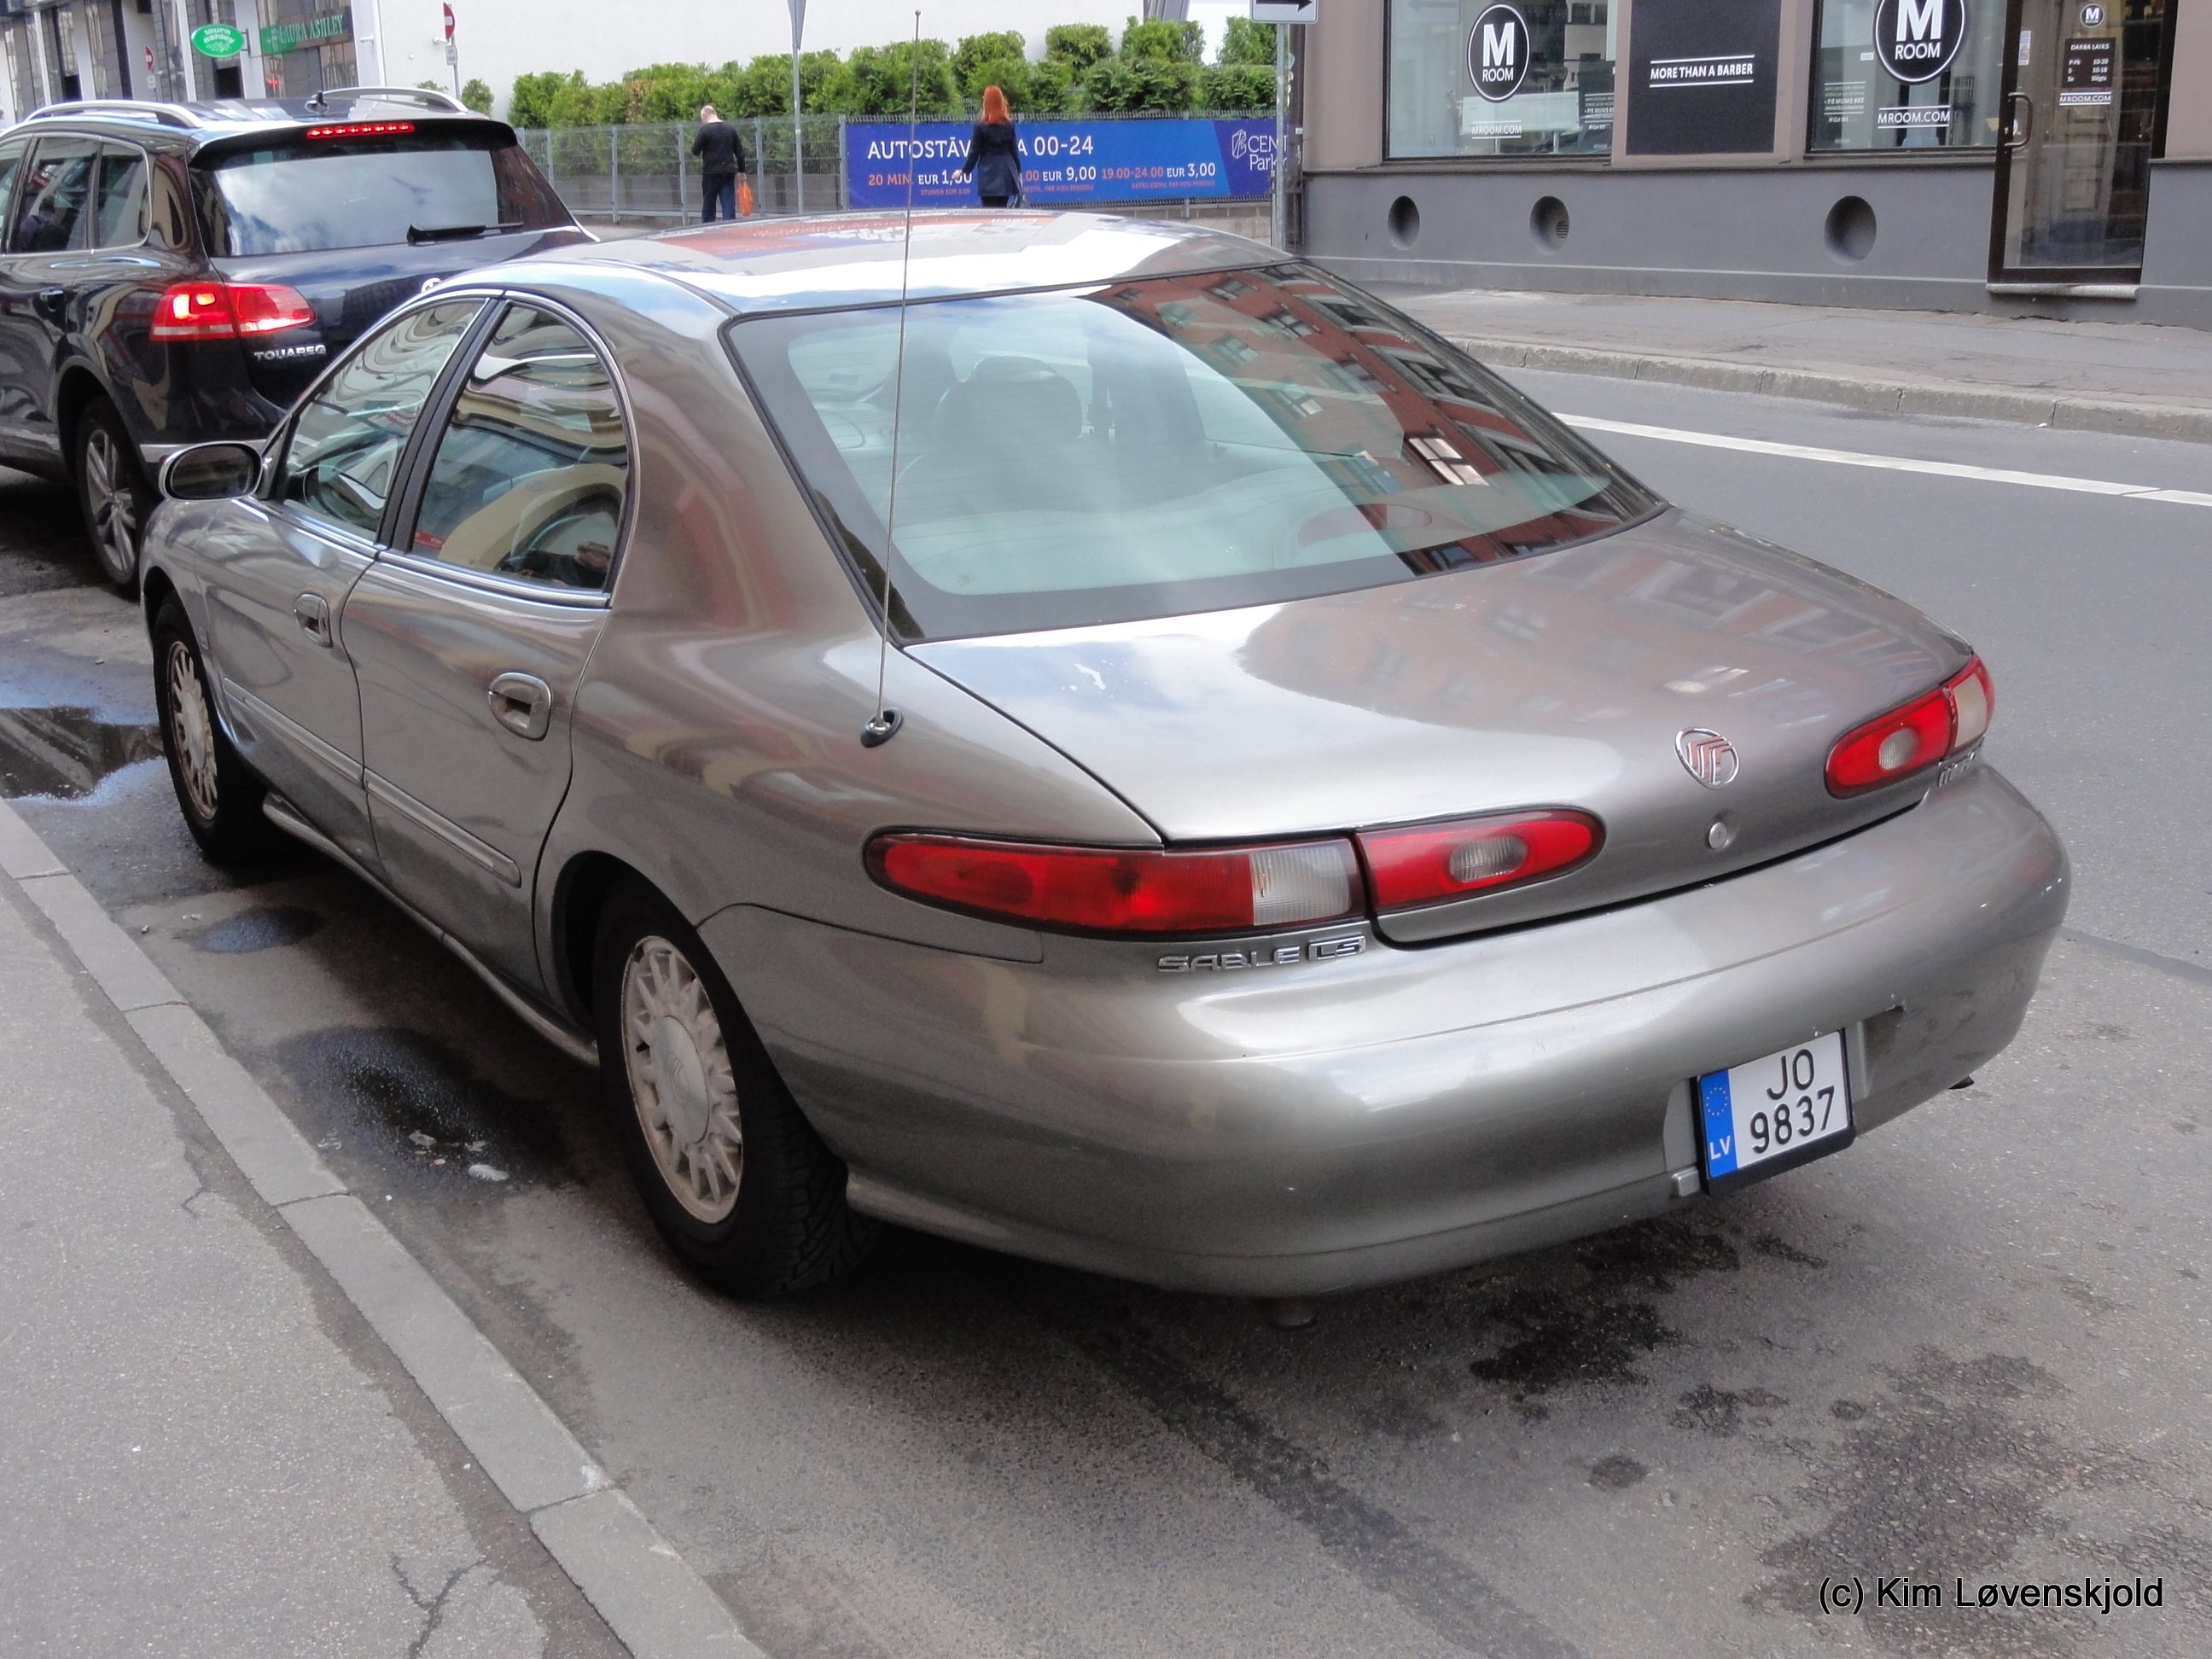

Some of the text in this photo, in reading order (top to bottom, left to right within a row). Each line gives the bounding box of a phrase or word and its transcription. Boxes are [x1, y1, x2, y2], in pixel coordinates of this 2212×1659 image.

[1896, 0, 1943, 42] M
[2086, 8, 2099, 20] M
[204, 27, 231, 36] laura
[278, 14, 344, 44] LAURA ASHLEY
[202, 33, 236, 44] ashley
[1482, 21, 1515, 67] M
[1895, 42, 1941, 61] ROOM
[1482, 67, 1515, 83] ROOM
[1650, 62, 1754, 80] MORE THAN A BARBER
[2059, 95, 2112, 103] MROOM.COM
[1877, 110, 1951, 125] MROOM.COM
[1471, 125, 1522, 136] MROOM.COM
[1033, 135, 1094, 156] 00-24
[868, 173, 883, 186] 20
[918, 173, 939, 185] EUR
[1042, 171, 1062, 183] EUR
[1065, 166, 1097, 183] 9,00
[1102, 167, 1164, 180] 19.00-24.00
[1167, 166, 1185, 178] EUR
[1187, 162, 1216, 179] 3,00
[253, 344, 327, 361] TOUAREG
[1158, 946, 1301, 973] SABLE
[1766, 1048, 1815, 1101] JO
[1749, 1085, 1835, 1154] 9837
[1709, 1135, 1731, 1160] LV
